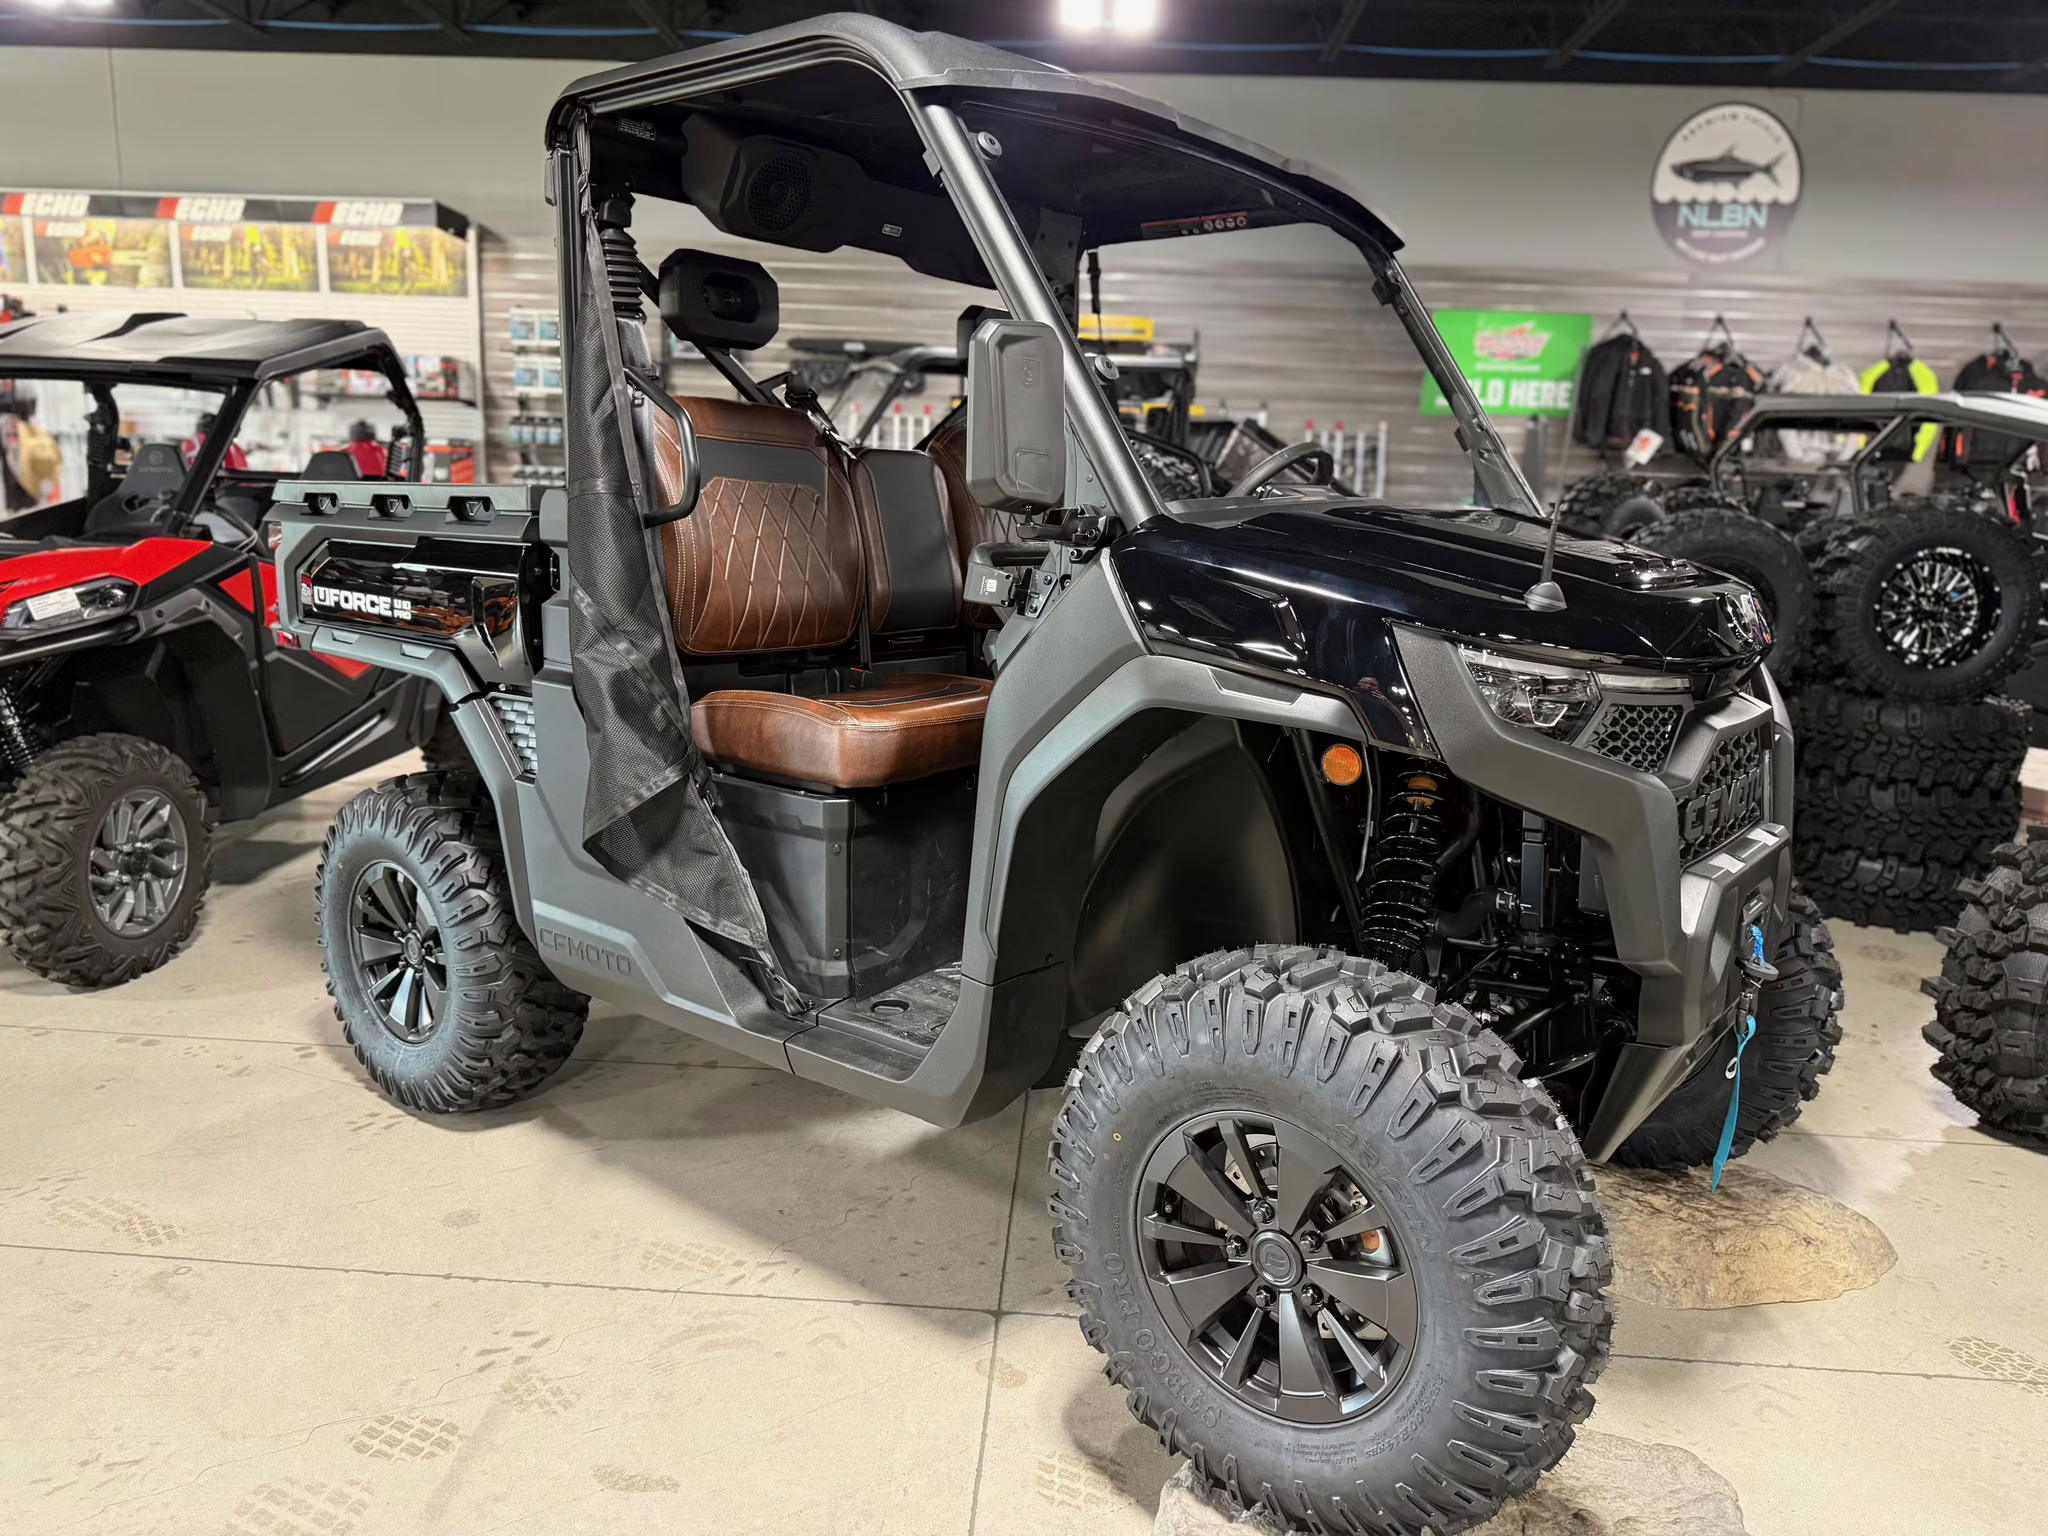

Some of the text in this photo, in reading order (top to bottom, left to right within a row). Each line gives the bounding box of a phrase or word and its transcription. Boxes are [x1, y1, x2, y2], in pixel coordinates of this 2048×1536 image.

[21, 194, 90, 216] ECHO
[175, 199, 245, 221] ECHO
[332, 203, 403, 225] ECHO
[1677, 203, 1769, 228] NLBN
[1508, 379, 1574, 410] HERE
[393, 609, 412, 621] PRO
[540, 927, 633, 977] CFMOTO
[1103, 1252, 1222, 1429] STEGO PRO
